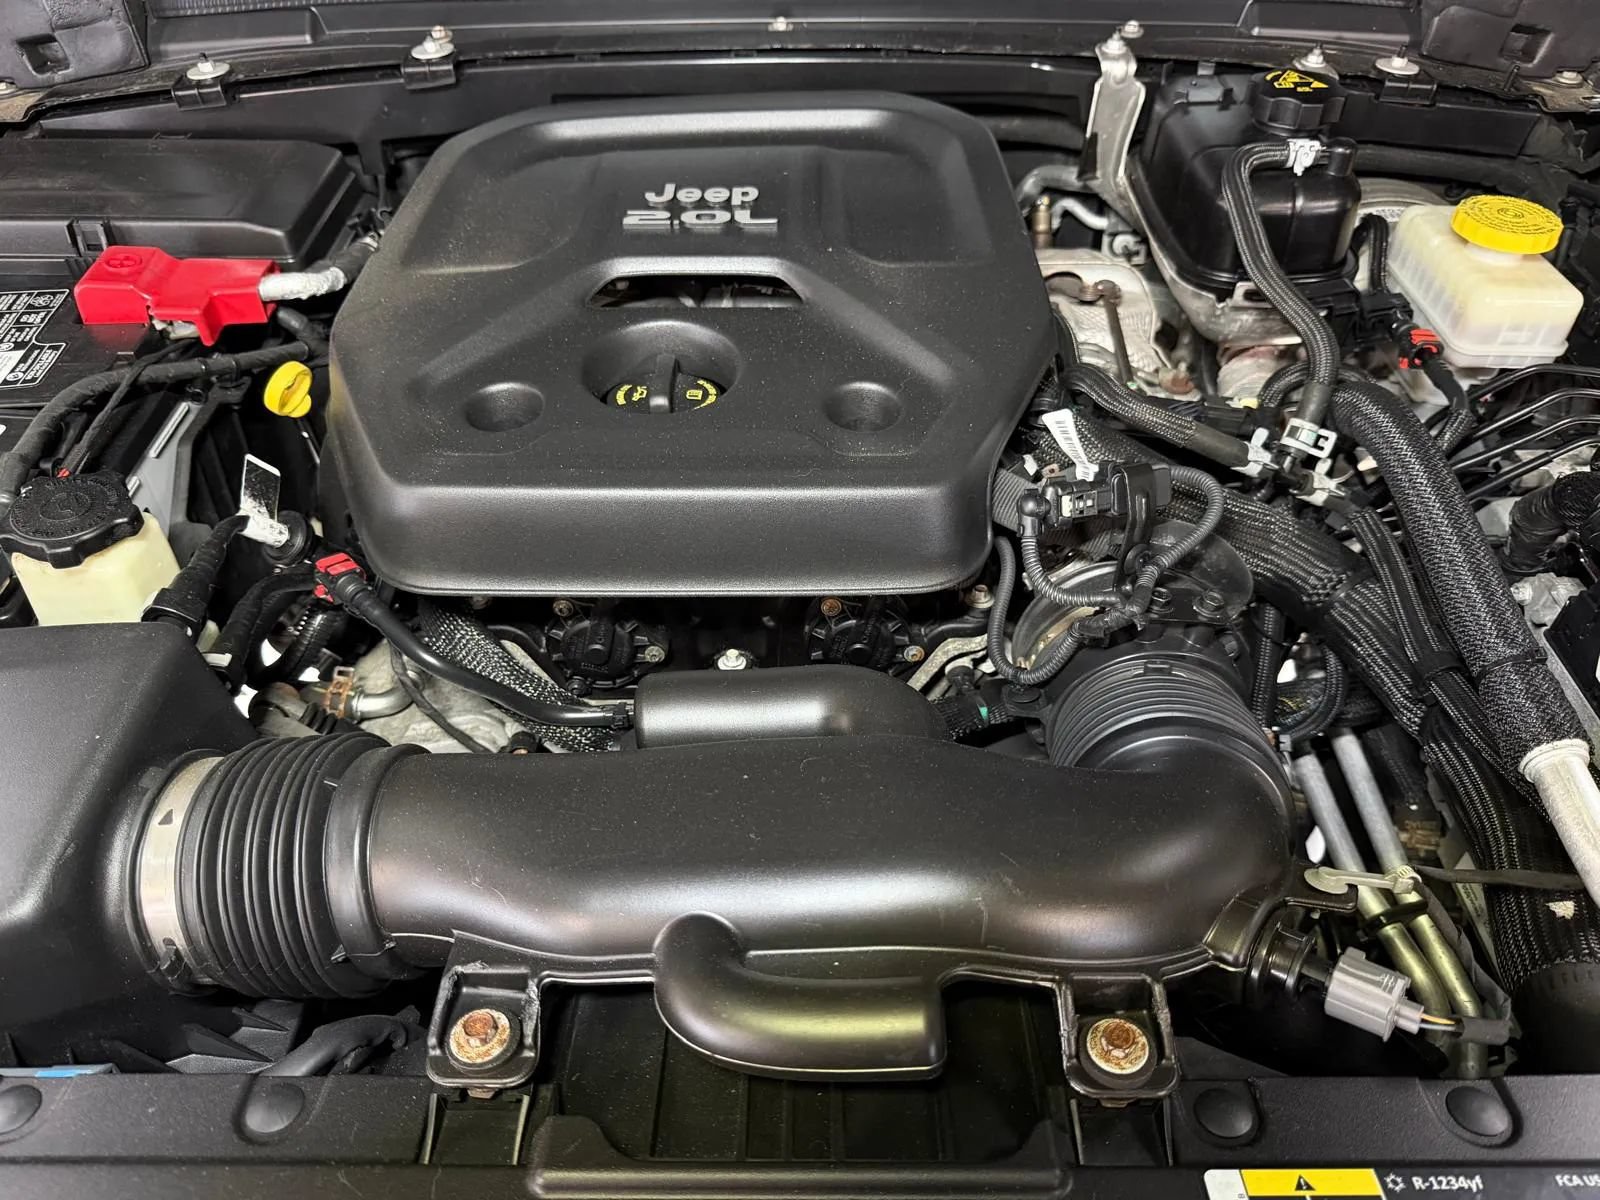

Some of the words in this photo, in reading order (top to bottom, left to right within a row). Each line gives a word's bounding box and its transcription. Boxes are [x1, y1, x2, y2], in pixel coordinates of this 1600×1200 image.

[645, 183, 759, 206] Jeep
[622, 209, 779, 228] 2.0L
[1411, 1174, 1484, 1193] R-1234yf
[1554, 1173, 1585, 1187] FCA
